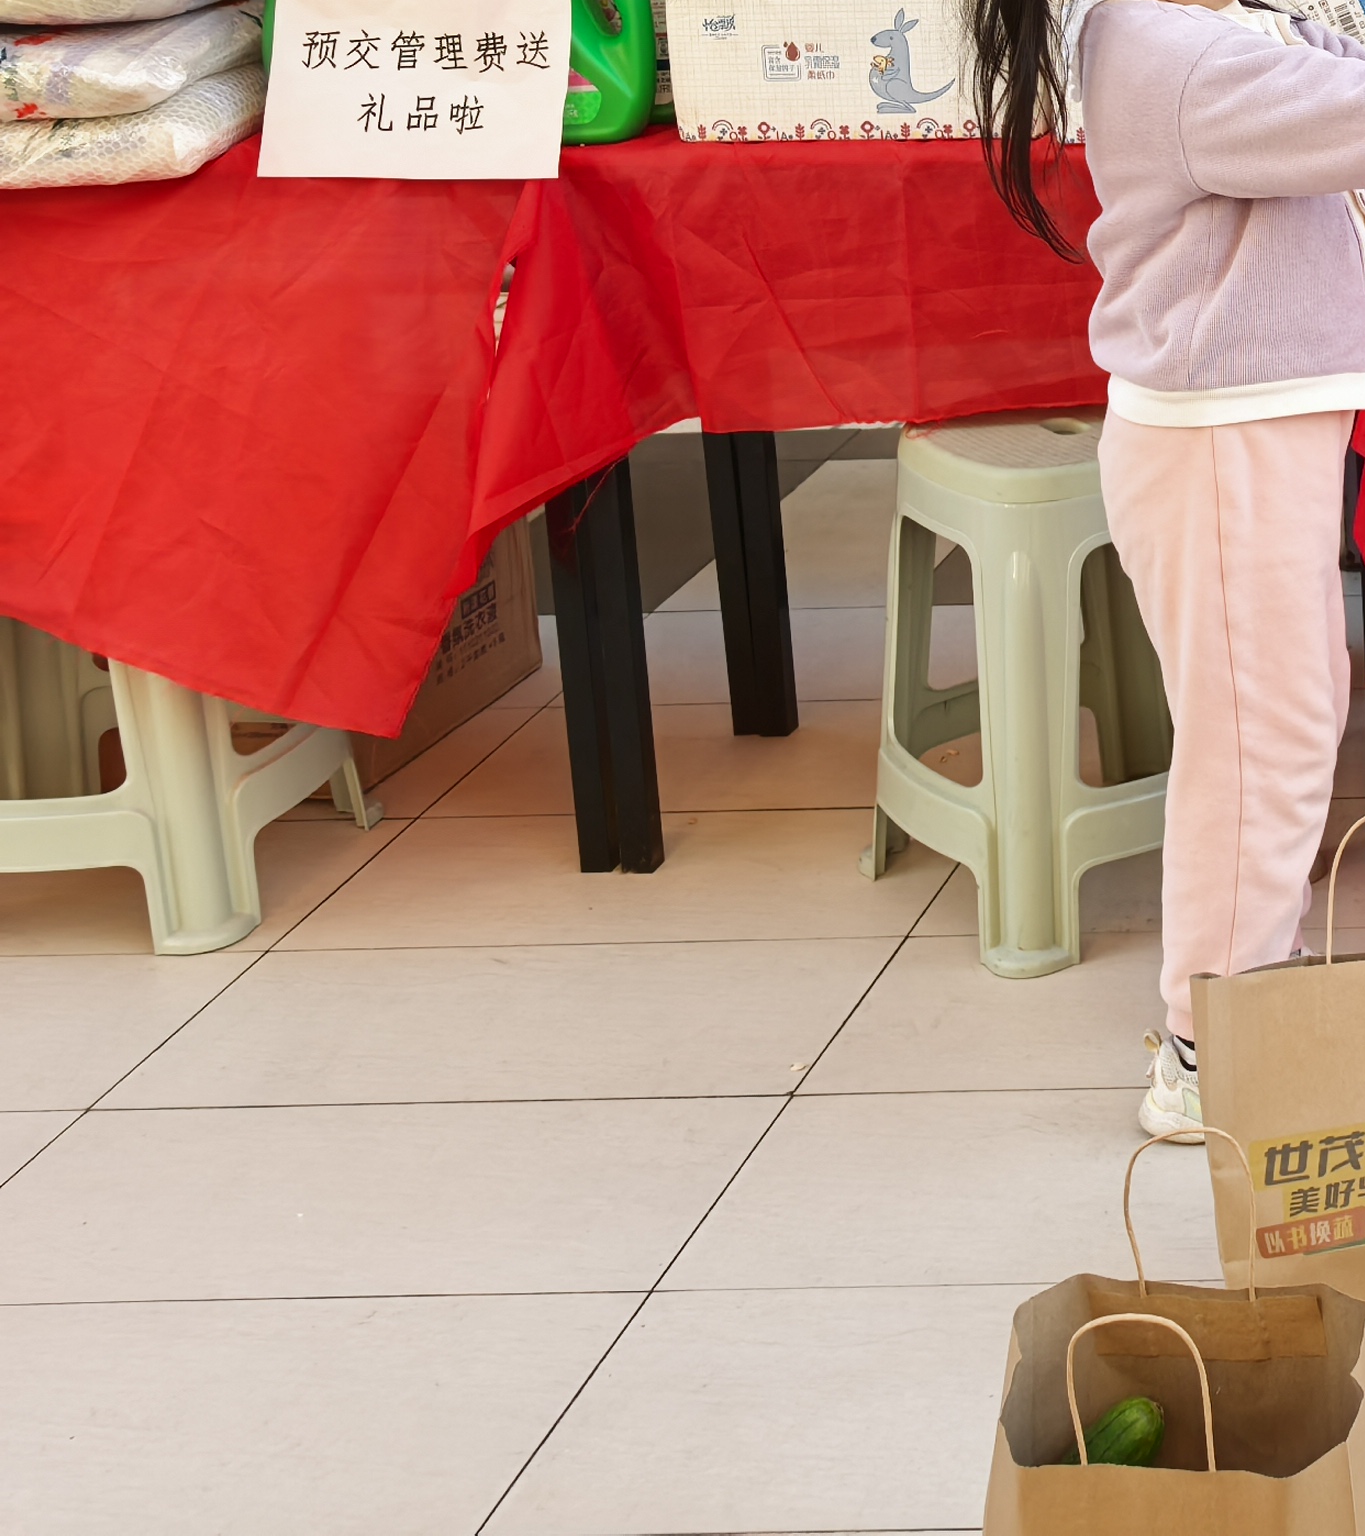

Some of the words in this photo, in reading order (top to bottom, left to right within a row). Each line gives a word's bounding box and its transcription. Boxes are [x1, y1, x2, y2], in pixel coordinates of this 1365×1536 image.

[301, 28, 551, 74] 预交管理费送
[356, 92, 485, 135] 礼品啦
